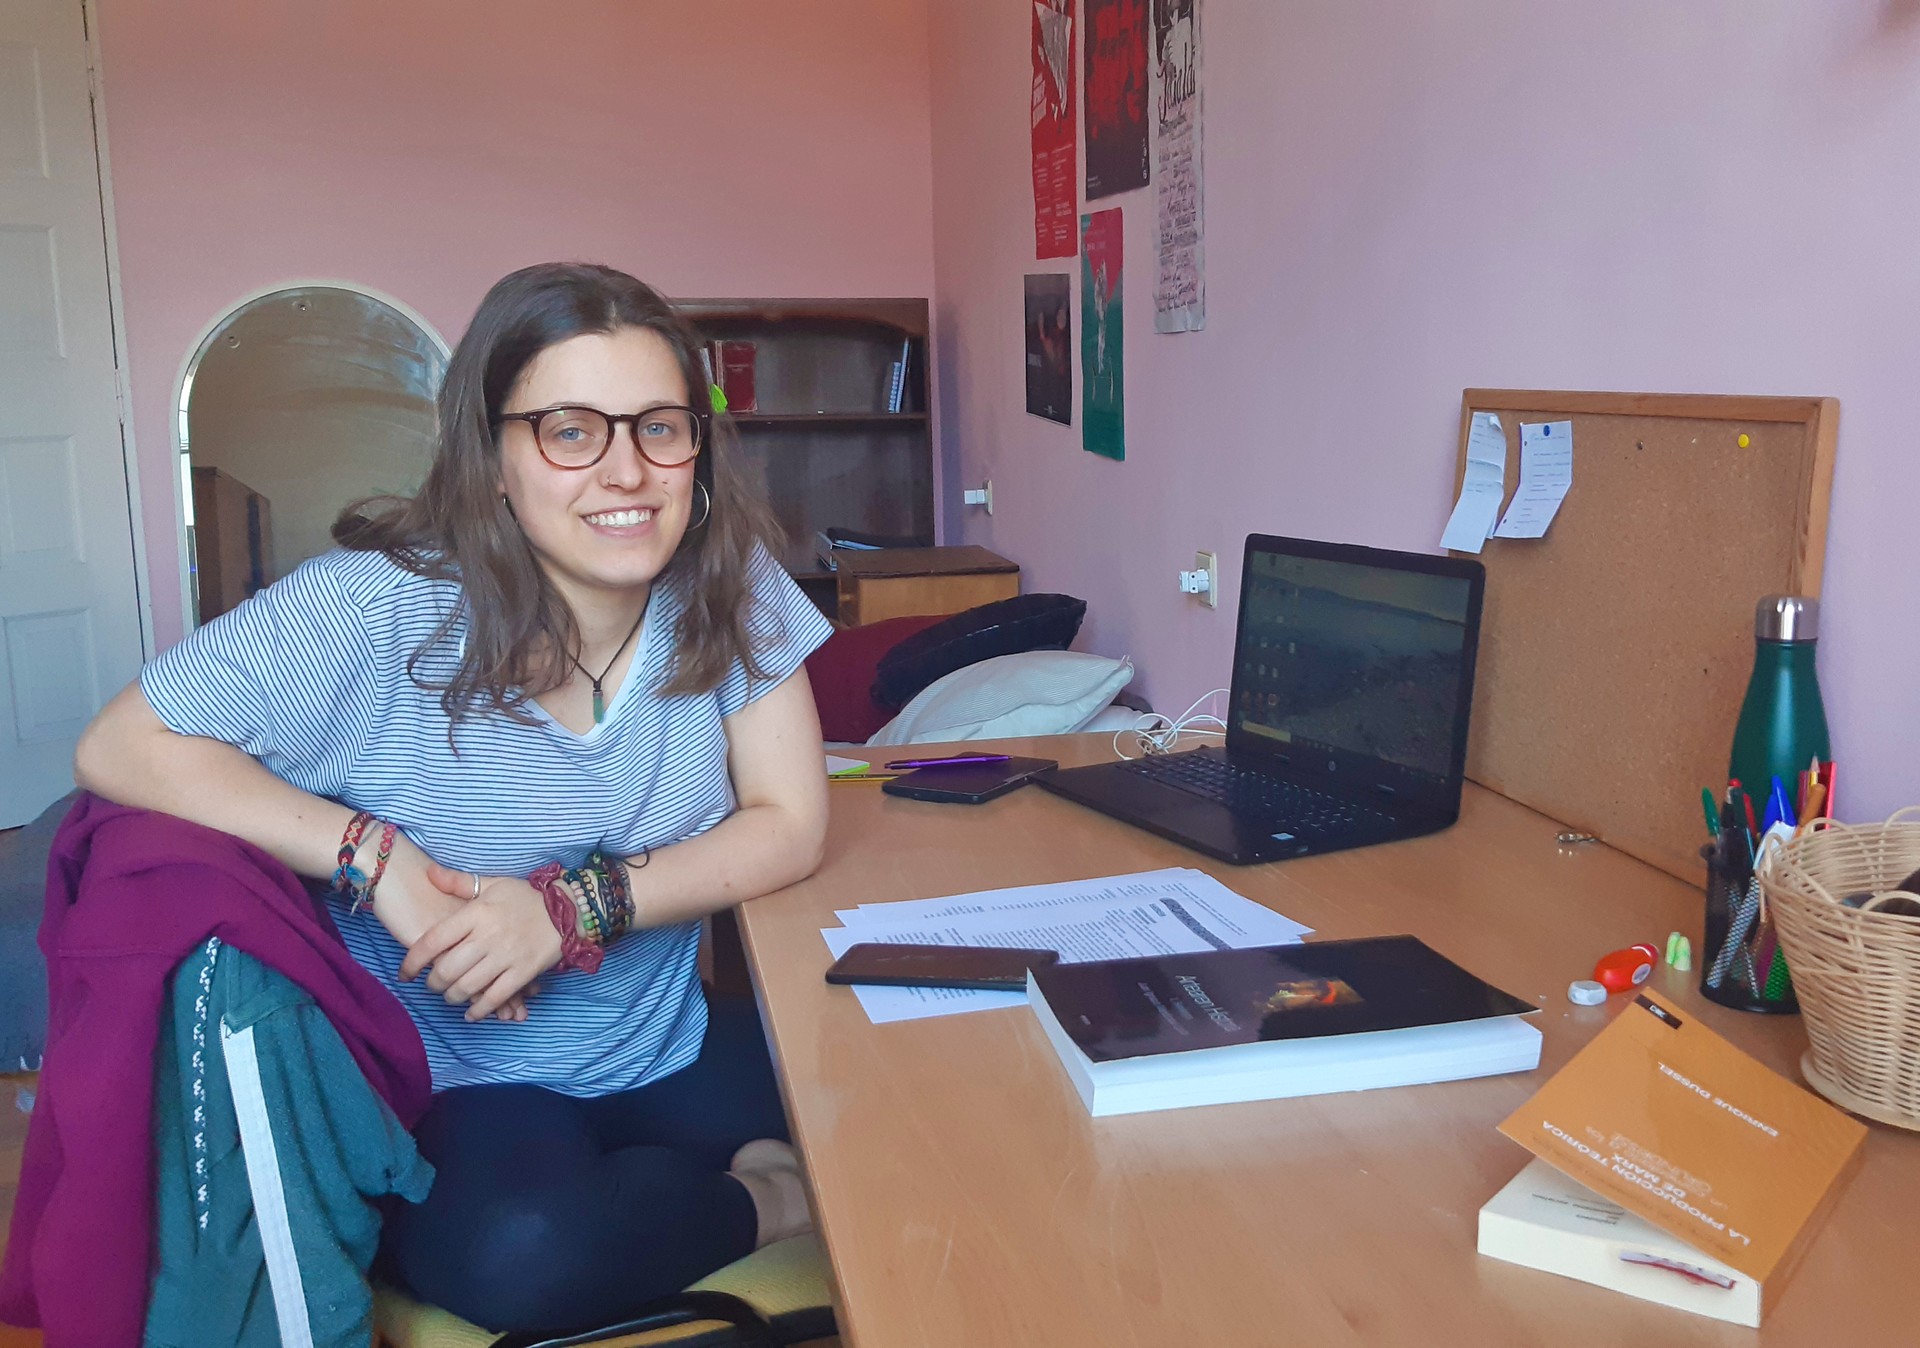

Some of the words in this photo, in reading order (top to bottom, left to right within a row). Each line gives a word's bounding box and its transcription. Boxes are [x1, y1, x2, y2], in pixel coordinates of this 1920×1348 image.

[1658, 1062, 1711, 1099] DUSSEL
[1712, 1097, 1779, 1137] ENRIQUE
[1543, 1120, 1609, 1167] TEÓRICA
[1611, 1153, 1660, 1183] MARX
[1612, 1164, 1726, 1231] PRODUCCIÓN
[1661, 1182, 1686, 1198] DE
[1728, 1228, 1751, 1246] LA
